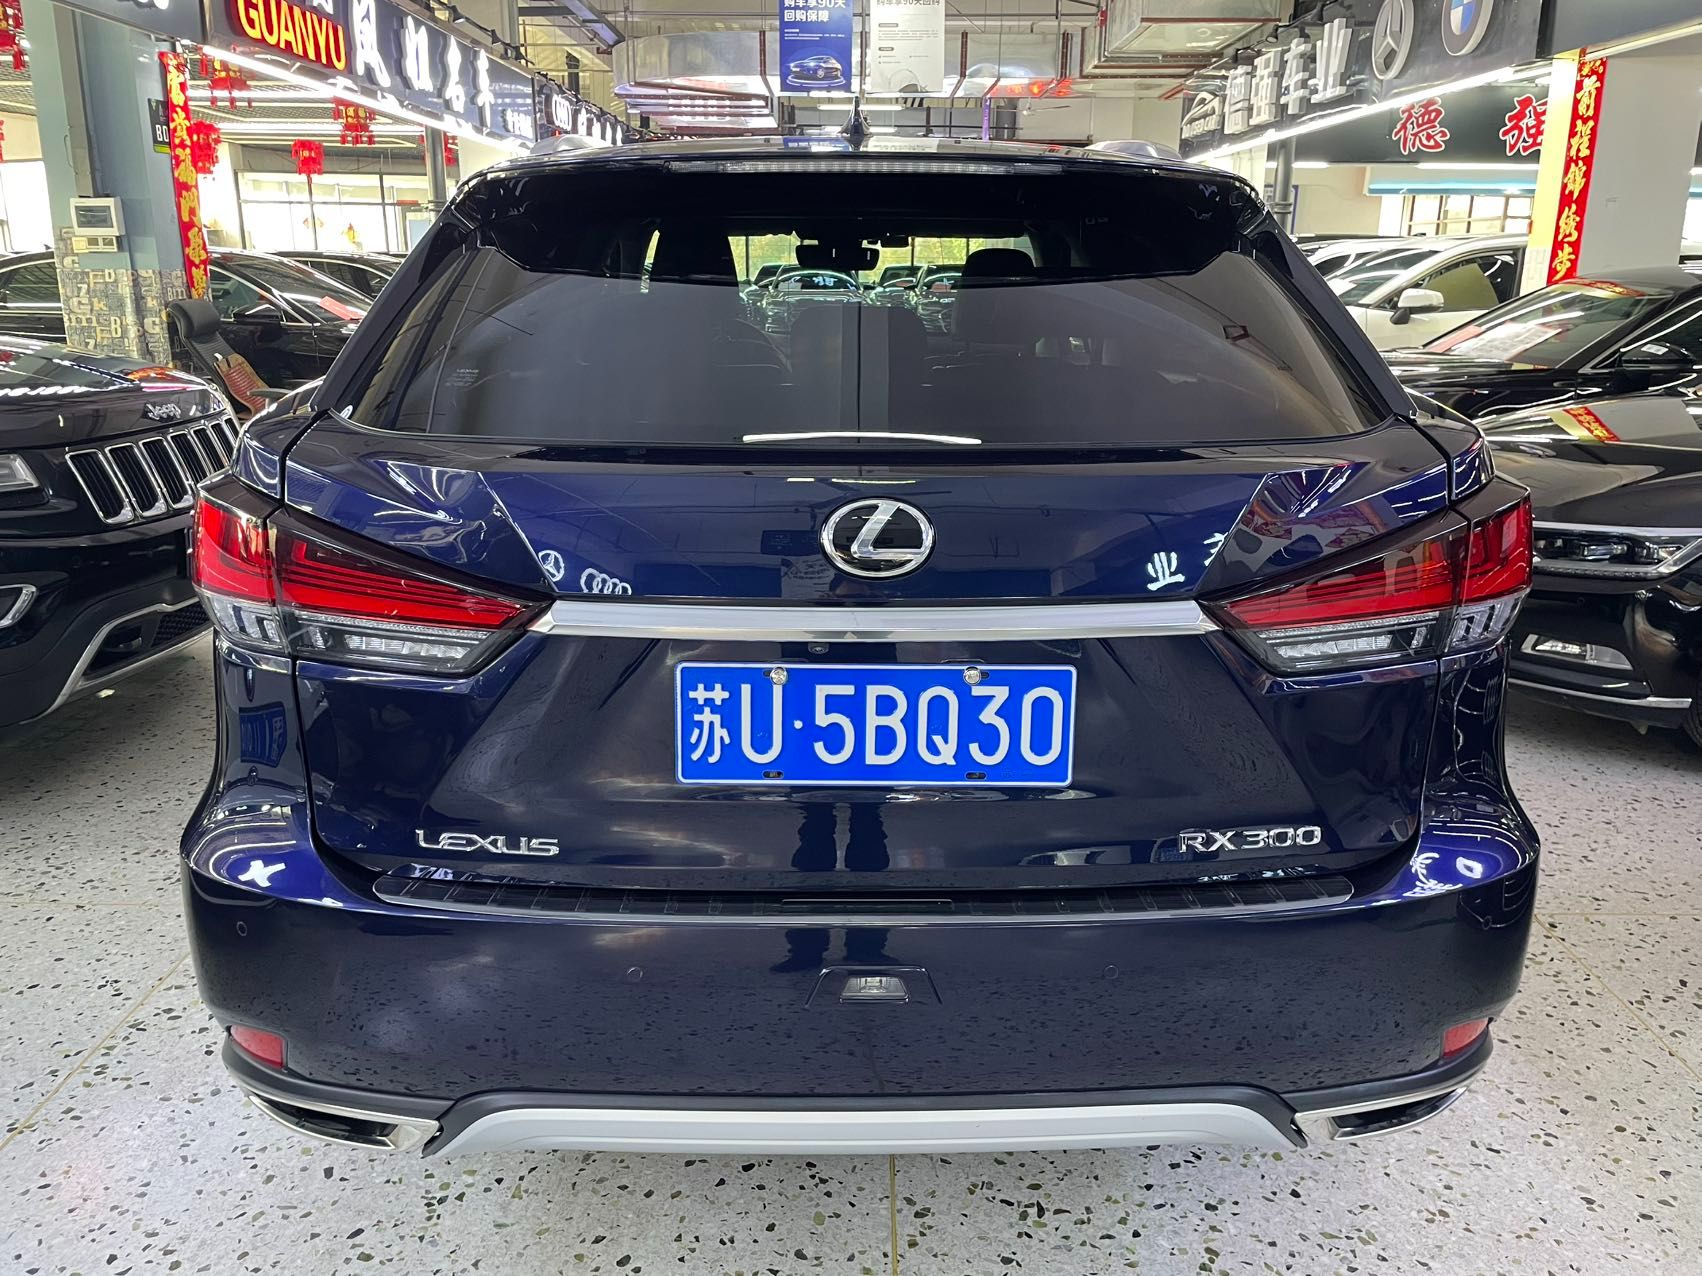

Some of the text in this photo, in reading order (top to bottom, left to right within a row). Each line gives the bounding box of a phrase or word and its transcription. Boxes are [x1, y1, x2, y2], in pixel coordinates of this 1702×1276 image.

[784, 10, 829, 22] 回购保障
[237, 0, 347, 71] GUANYU
[146, 402, 182, 420] Jeep
[689, 682, 1064, 766] 苏U·5BQ30
[415, 829, 560, 857] LEXUS
[1179, 826, 1322, 853] RX 300
